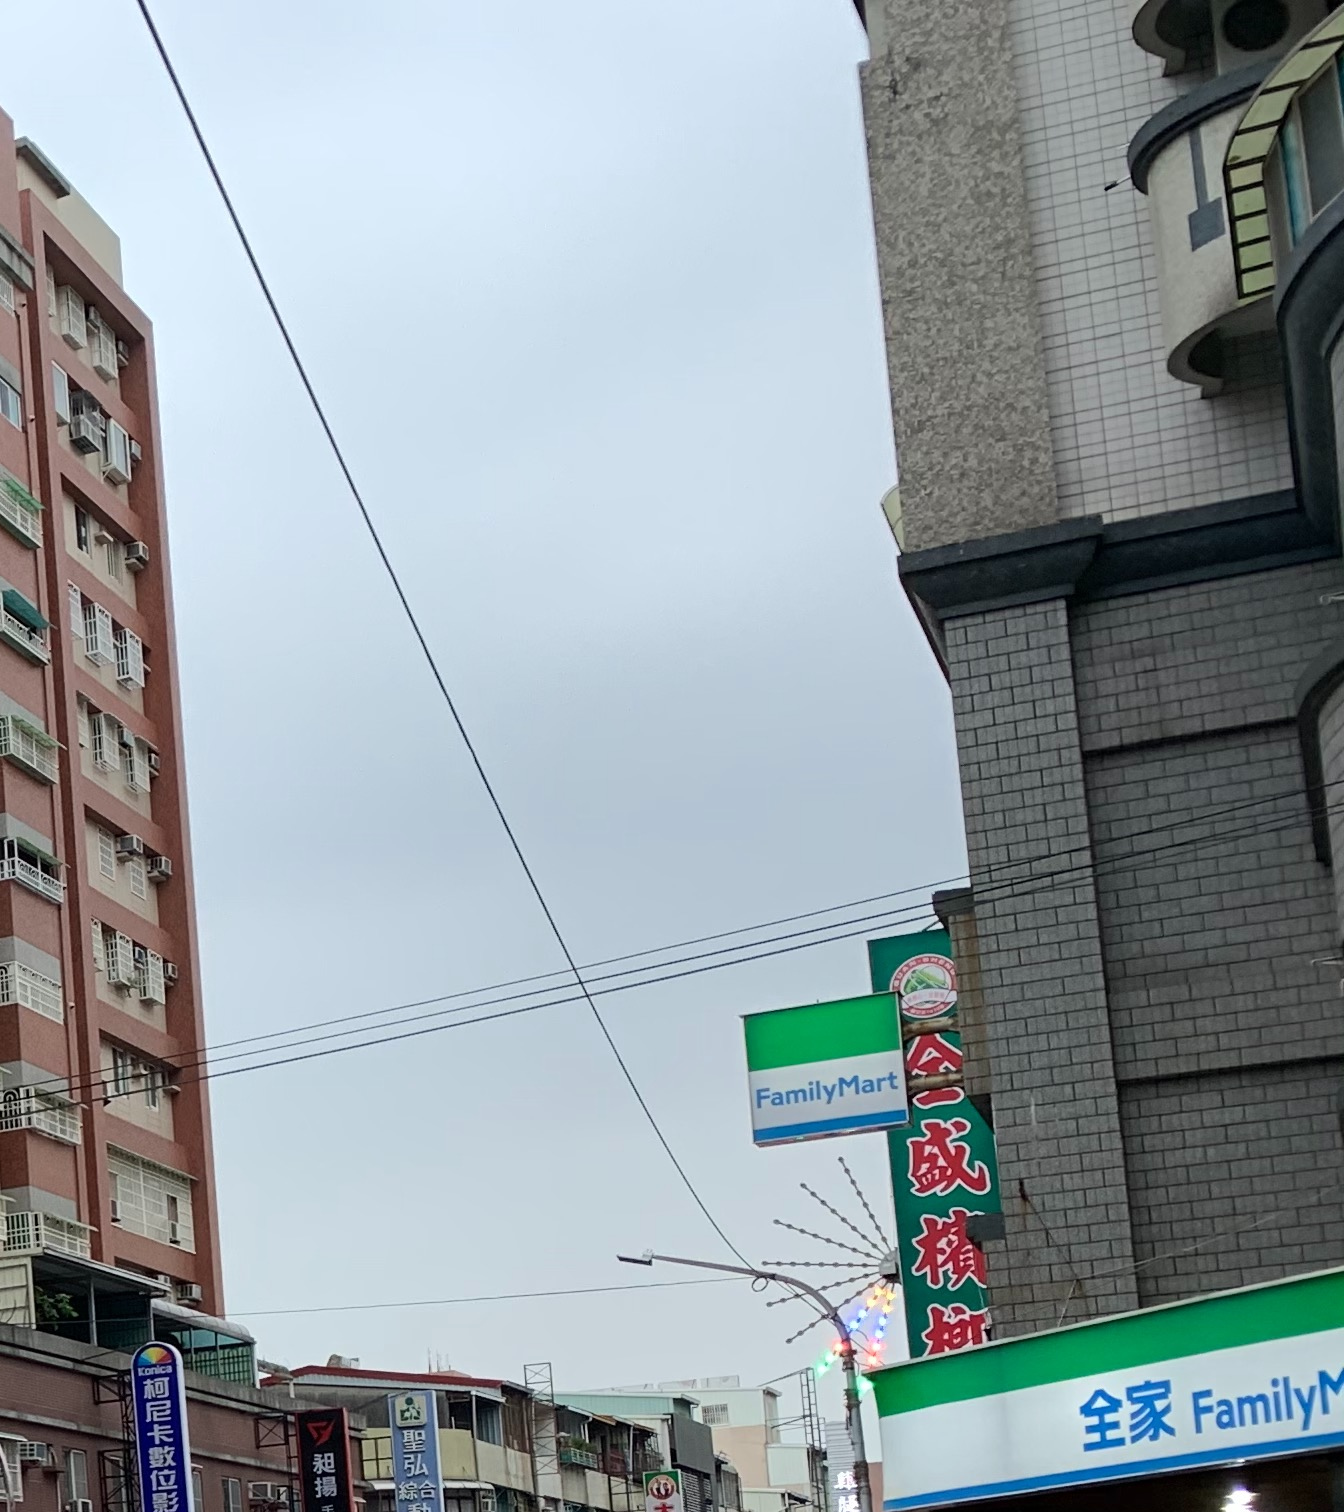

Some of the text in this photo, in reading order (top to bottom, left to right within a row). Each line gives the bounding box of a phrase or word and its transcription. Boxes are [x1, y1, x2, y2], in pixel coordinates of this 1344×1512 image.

[754, 1068, 899, 1110] FamilyMart
[137, 1365, 174, 1377] Konica
[1079, 1379, 1177, 1453] 全家
